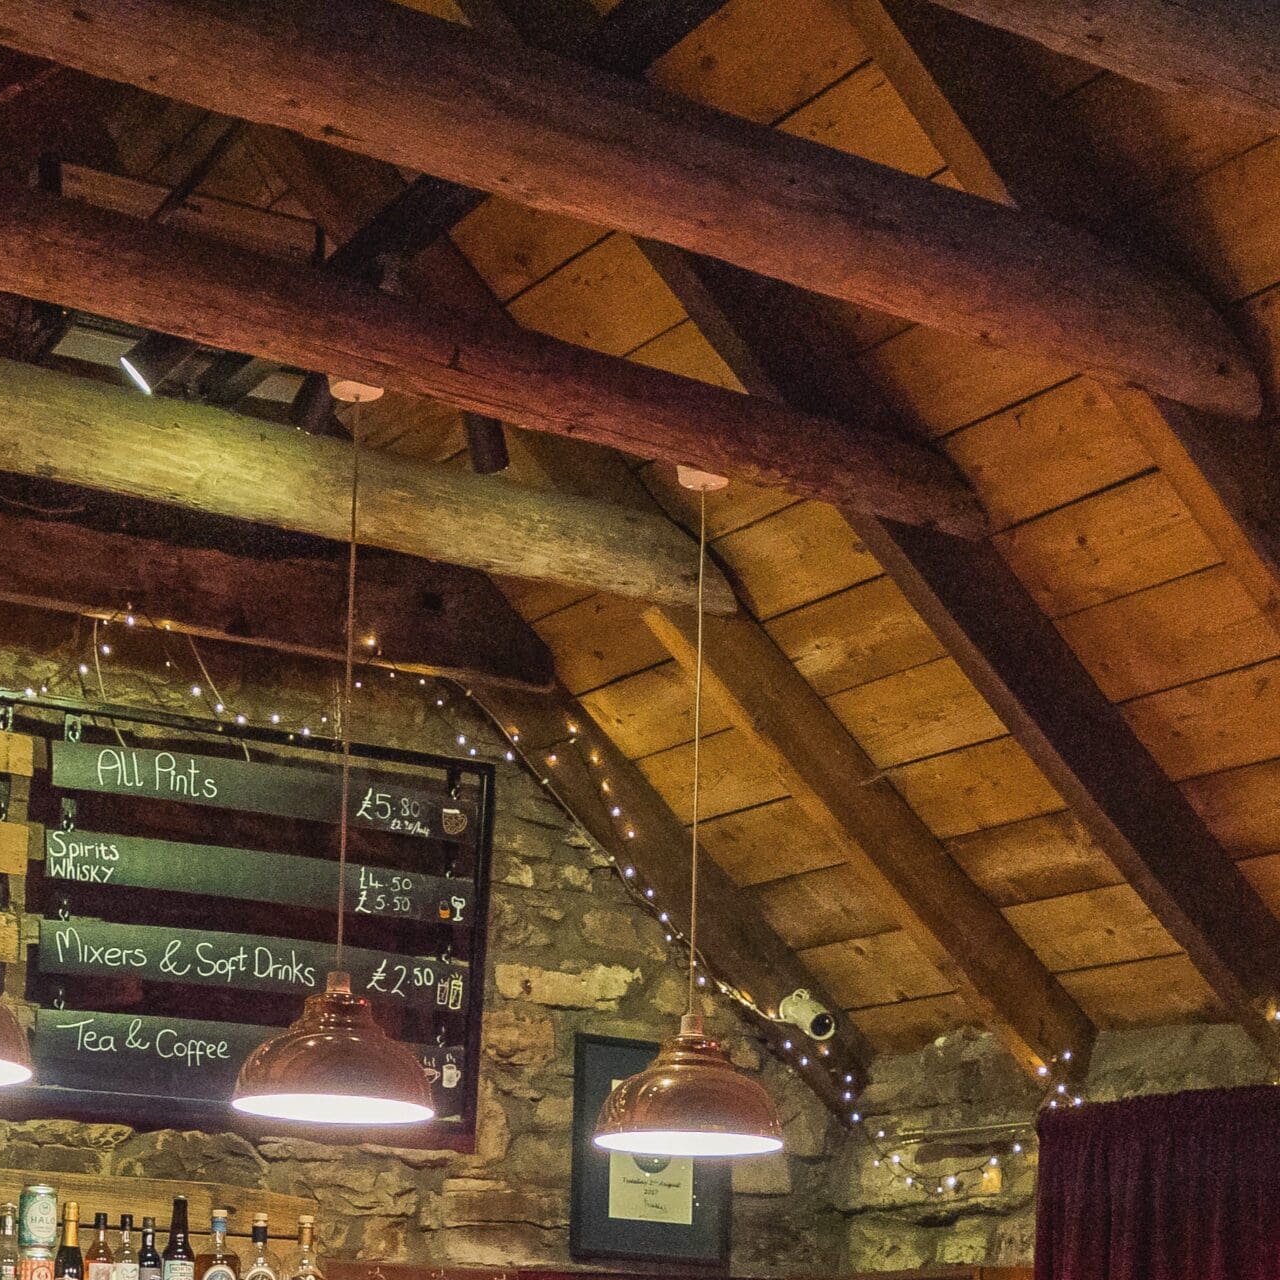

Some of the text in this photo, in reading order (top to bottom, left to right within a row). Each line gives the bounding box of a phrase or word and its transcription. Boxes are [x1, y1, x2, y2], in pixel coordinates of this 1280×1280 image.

[97, 748, 219, 799] All Pints
[356, 787, 421, 821] £5.80
[50, 832, 120, 863] Spirits
[359, 866, 413, 892] £4.50
[355, 890, 411, 914] £5.50
[55, 927, 316, 988] Mixers & Soft Drinks
[365, 958, 435, 998] £2.50
[55, 1018, 231, 1067] Tea & Coffee
